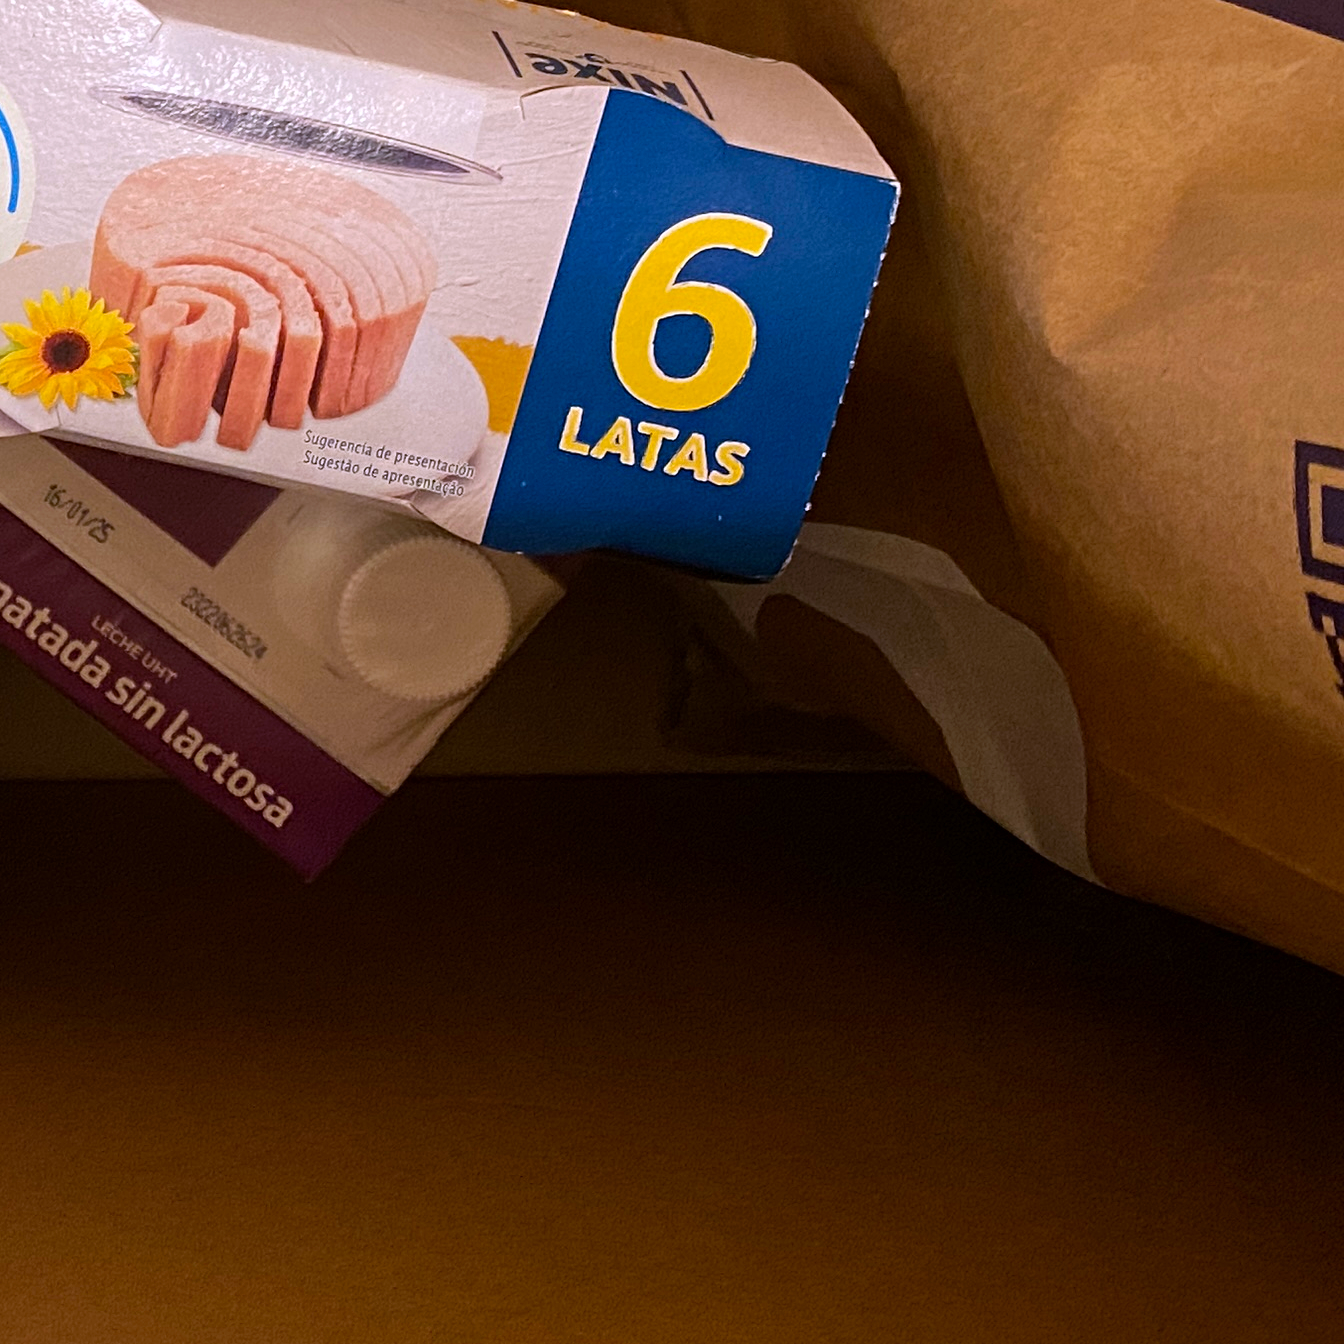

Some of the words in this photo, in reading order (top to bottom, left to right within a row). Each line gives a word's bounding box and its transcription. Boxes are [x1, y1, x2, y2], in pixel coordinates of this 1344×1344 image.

[611, 210, 773, 413] 6
[302, 450, 361, 476] Sugestão
[362, 462, 380, 481] de
[381, 466, 466, 500] apresentação
[303, 428, 373, 463] Sugerencia
[374, 442, 391, 463] de
[392, 446, 476, 481] presentación
[558, 406, 751, 488] LATAS
[42, 481, 117, 546] 16/01/25
[90, 614, 145, 662] LECHE
[140, 653, 180, 689] UHT
[105, 671, 168, 741] sin
[160, 716, 296, 833] lactosa
